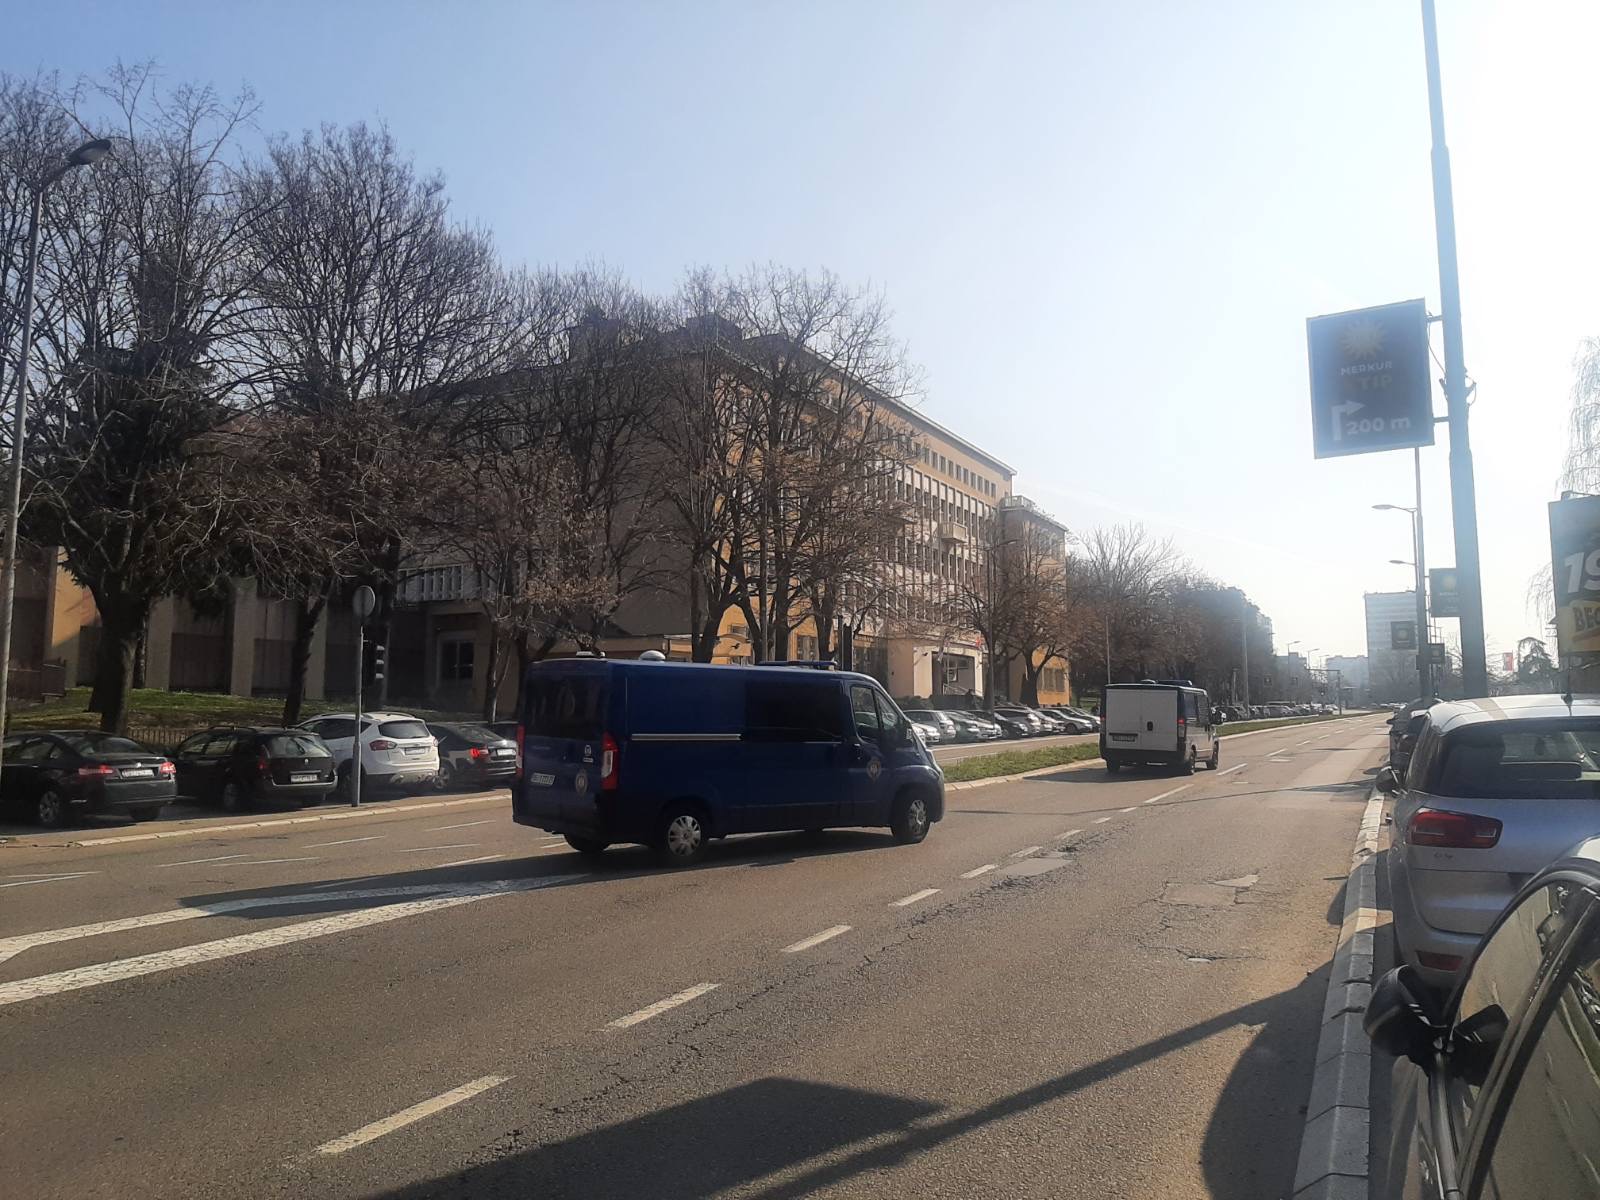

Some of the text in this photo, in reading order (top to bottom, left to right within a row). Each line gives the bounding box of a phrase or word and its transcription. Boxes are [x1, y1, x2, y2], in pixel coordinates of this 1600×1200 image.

[1340, 360, 1393, 376] MERKUR
[1360, 374, 1393, 390] TIP
[1345, 417, 1411, 435] 200 m
